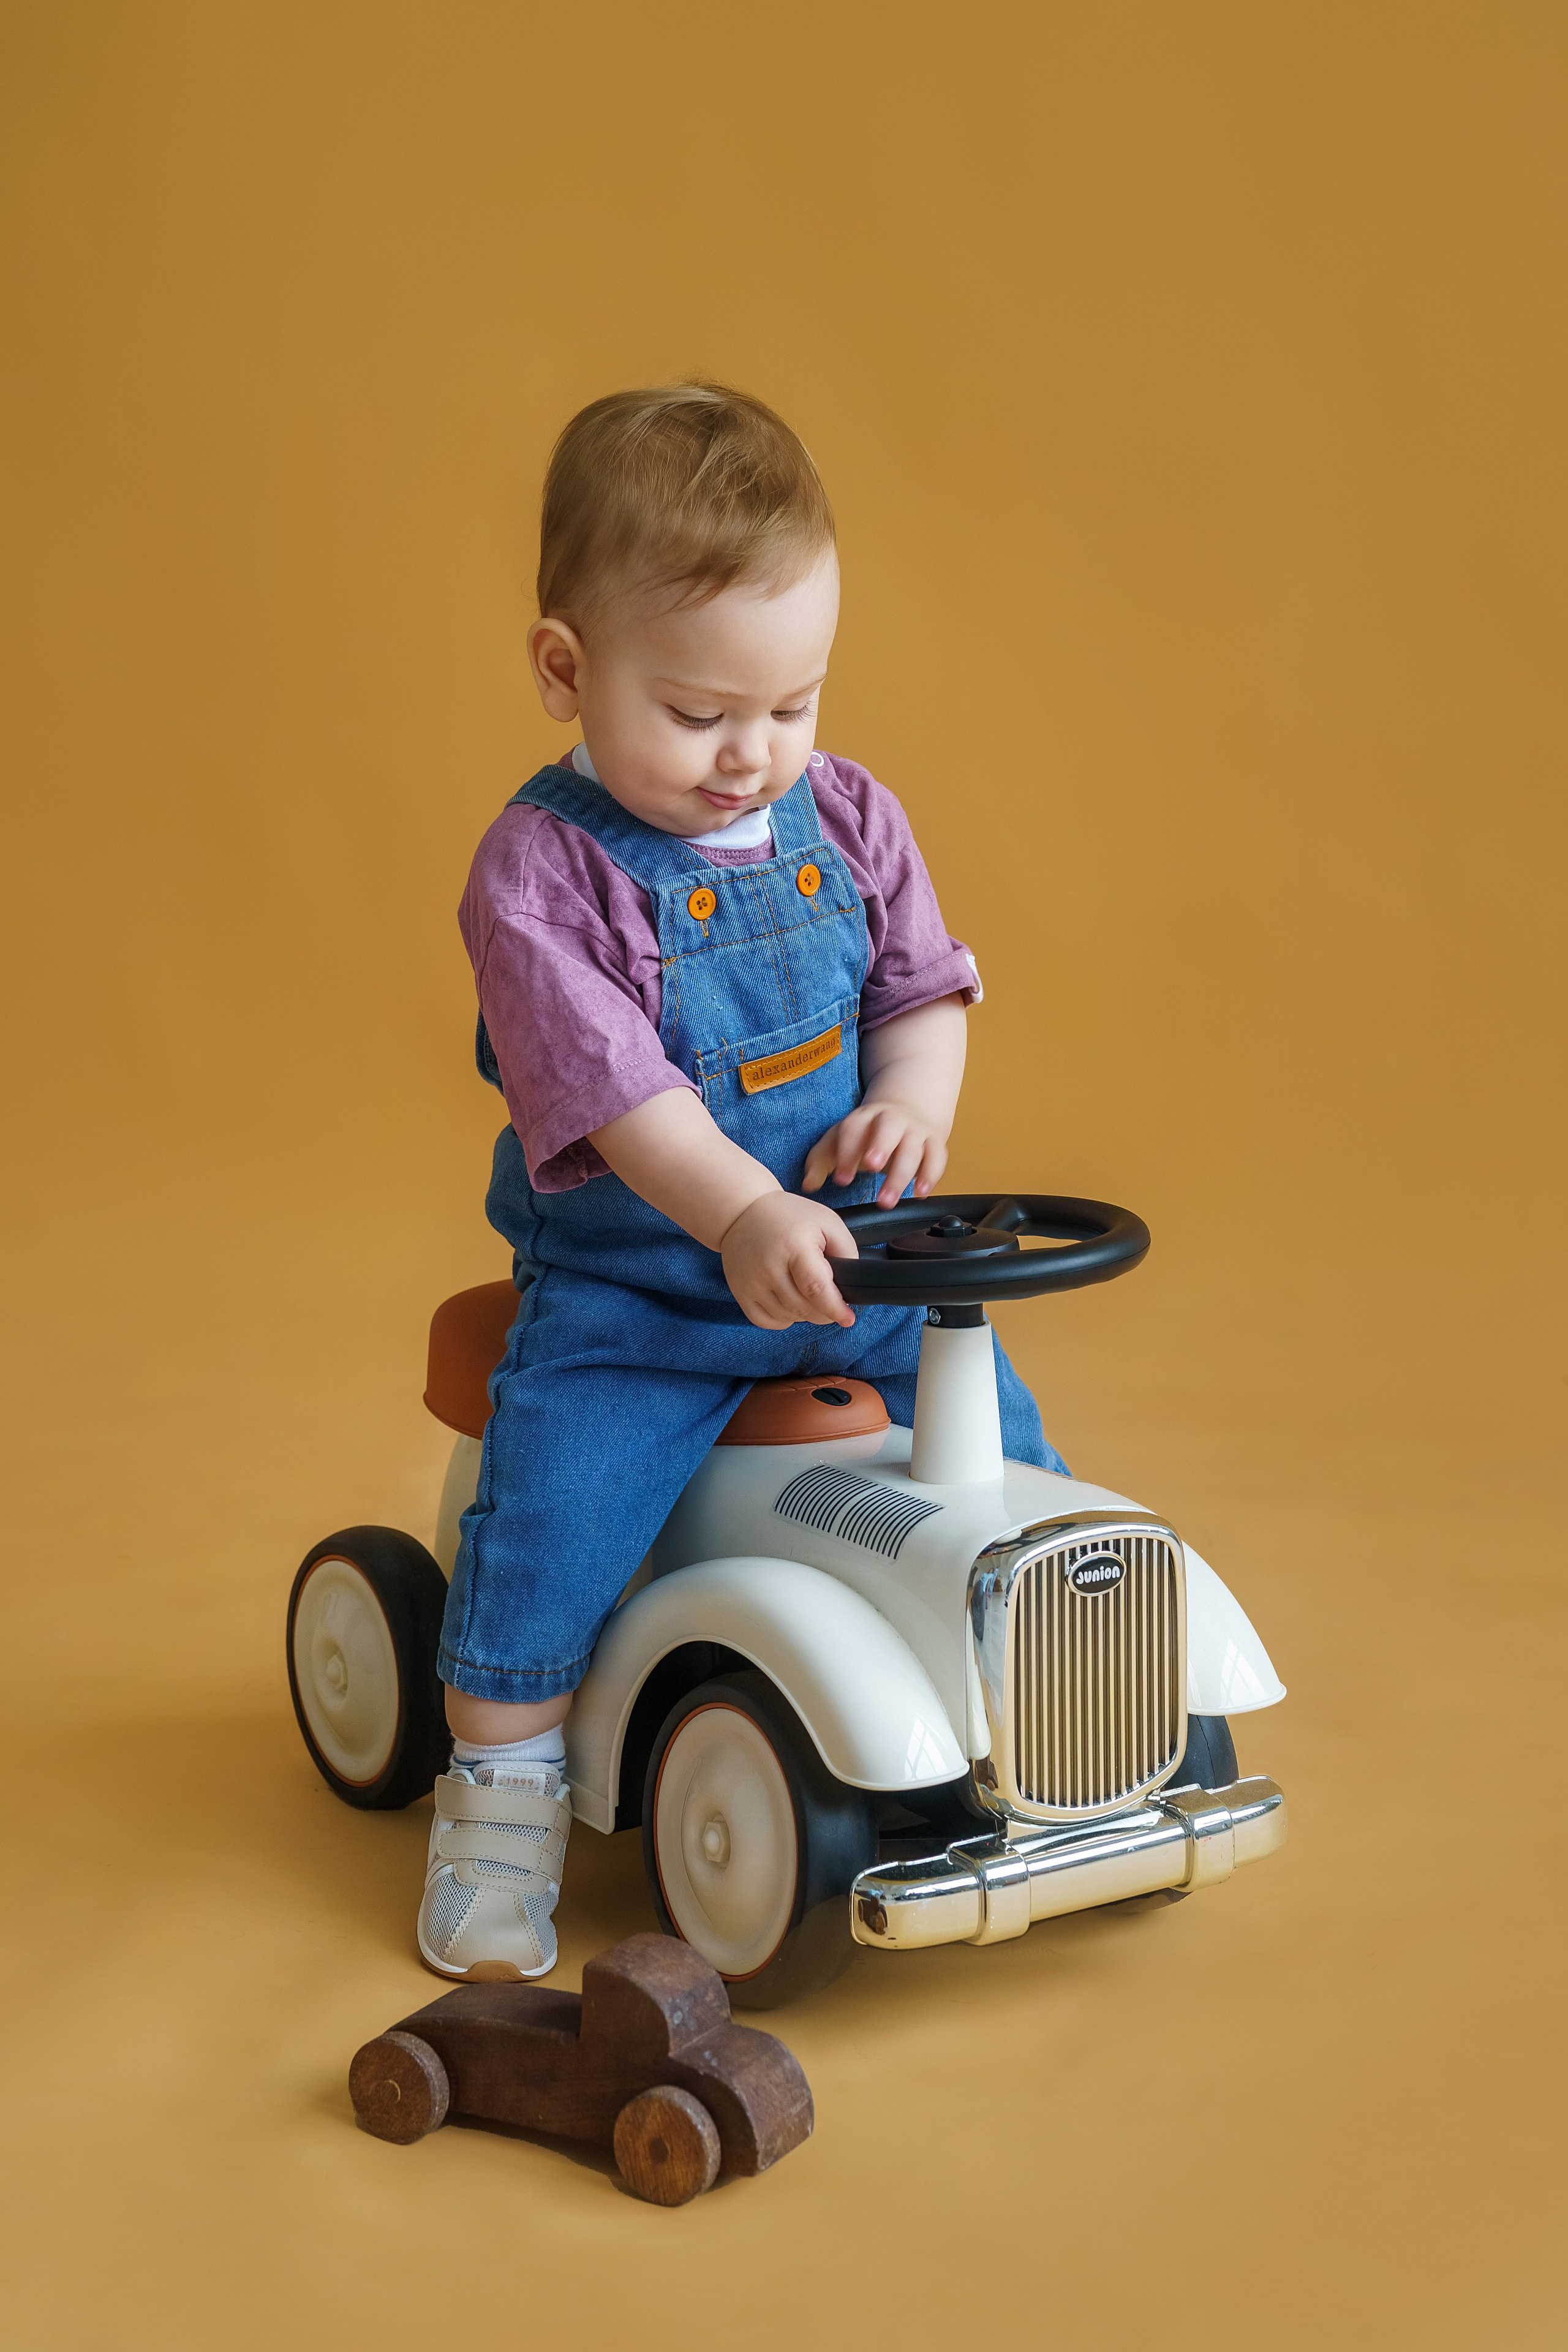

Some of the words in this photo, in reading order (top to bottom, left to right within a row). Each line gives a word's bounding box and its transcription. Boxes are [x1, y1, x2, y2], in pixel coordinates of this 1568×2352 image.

[752, 1036, 835, 1081] alexanderwang
[1076, 1566, 1120, 1585] Junion
[507, 1777, 533, 1787] 1999
